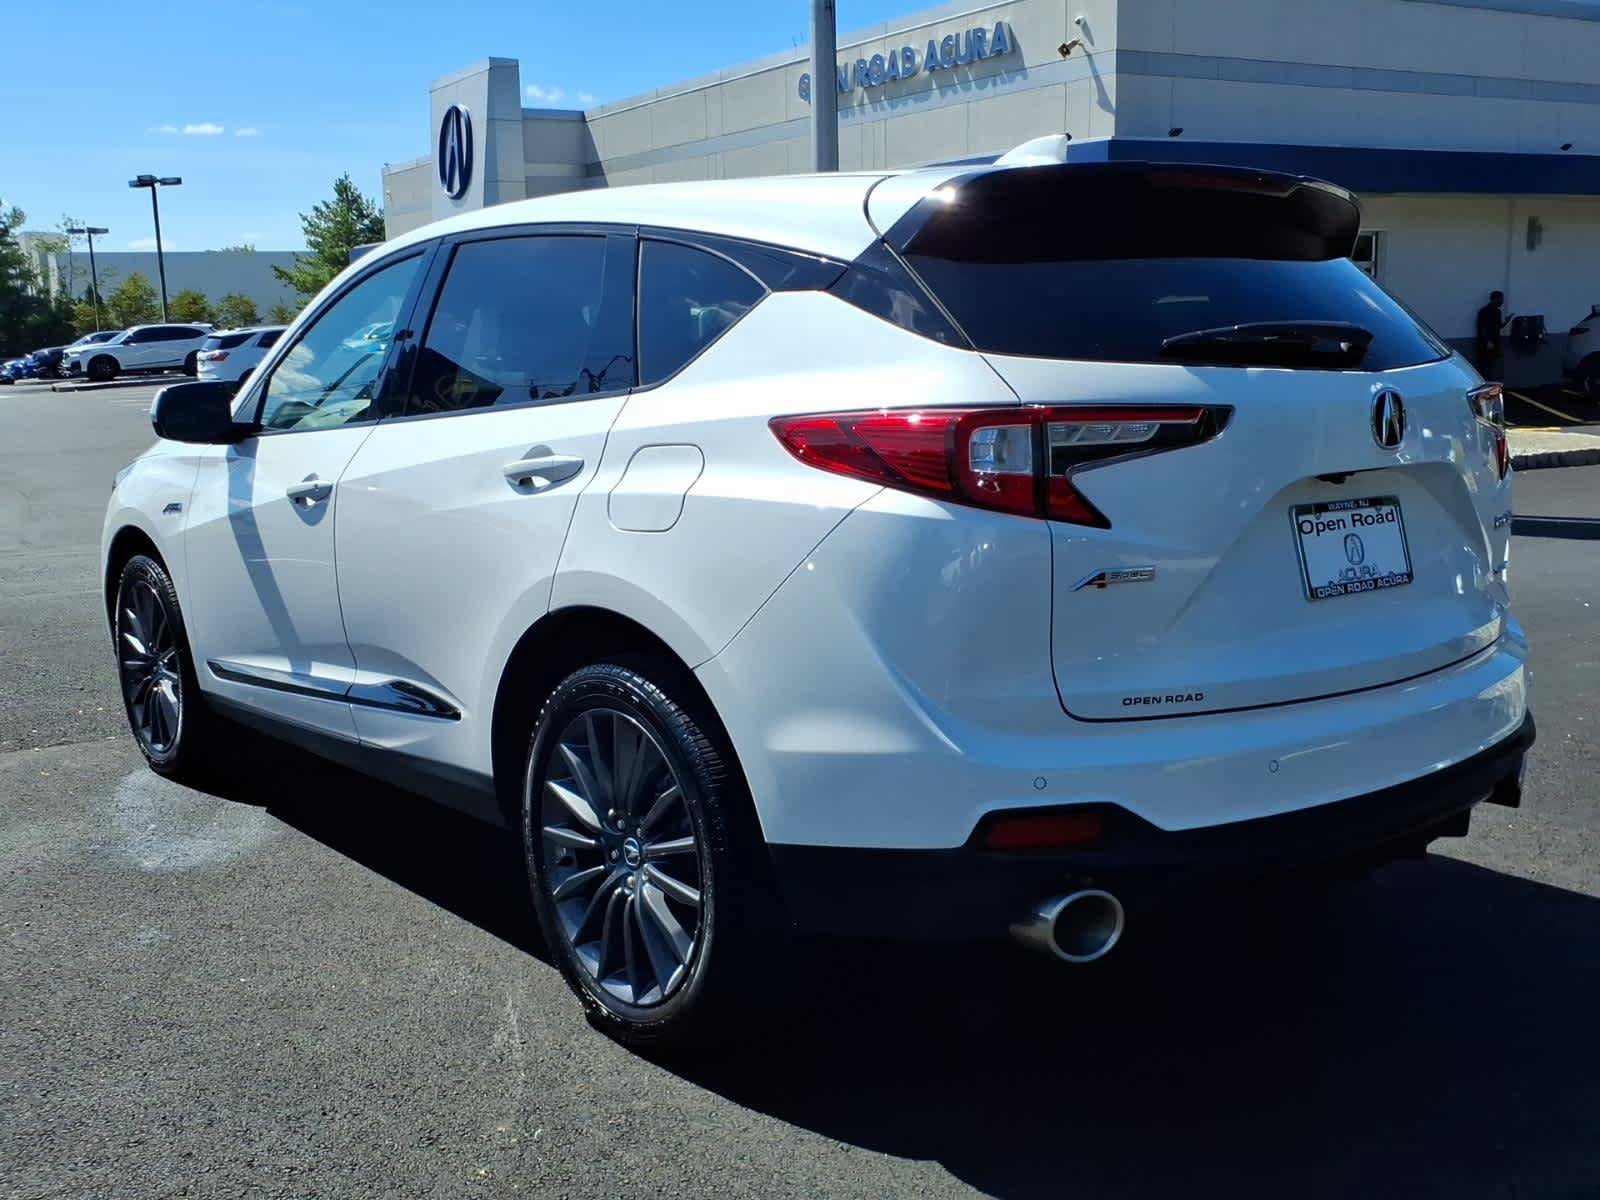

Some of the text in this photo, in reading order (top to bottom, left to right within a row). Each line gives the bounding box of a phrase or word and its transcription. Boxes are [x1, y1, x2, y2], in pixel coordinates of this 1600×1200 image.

[798, 21, 1009, 102] ON ROAD ACURA
[1300, 508, 1396, 537] Open Road
[1317, 574, 1409, 598] OPEN ROAD ACURA
[1122, 692, 1204, 706] OPEN ROAD
